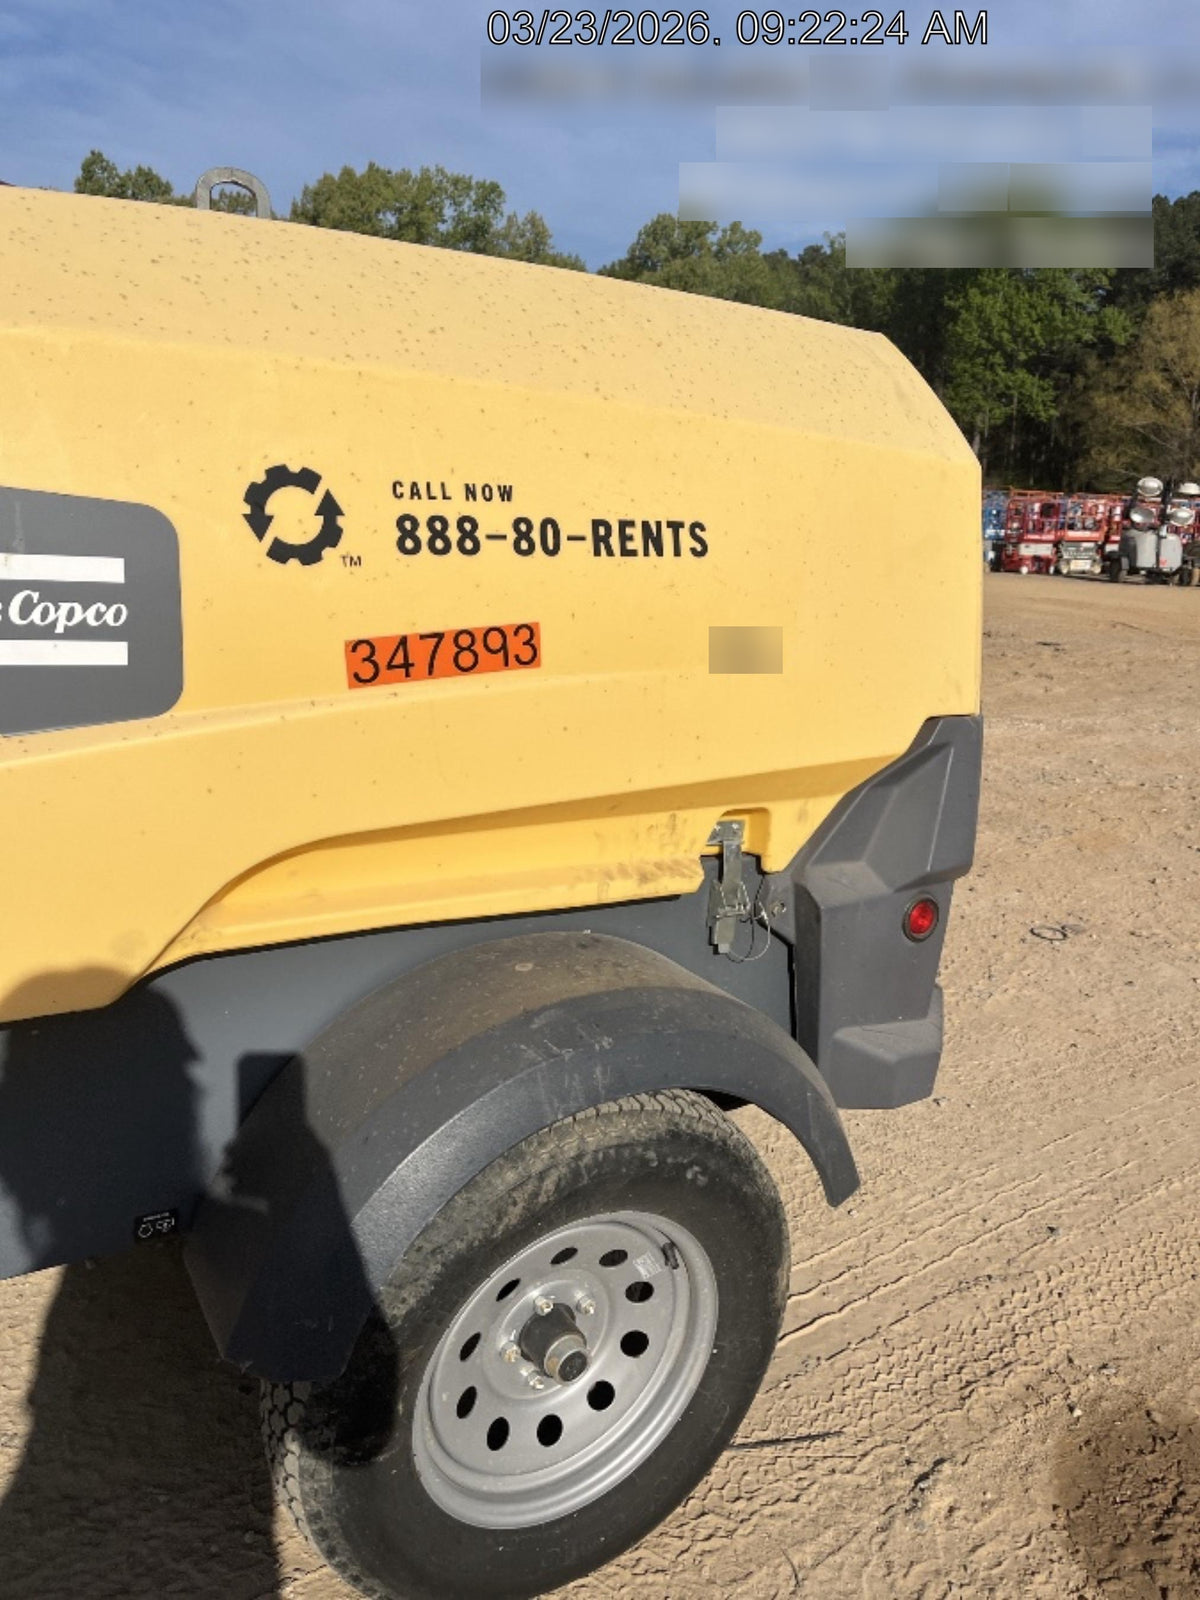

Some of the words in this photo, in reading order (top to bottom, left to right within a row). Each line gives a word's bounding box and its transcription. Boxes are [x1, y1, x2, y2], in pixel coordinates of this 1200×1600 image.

[392, 480, 452, 501] CALL
[464, 484, 513, 502] NOW
[395, 514, 709, 558] 888-80-RENTS
[340, 556, 361, 567] TM
[8, 590, 128, 633] Copco
[350, 624, 537, 685] 347893
